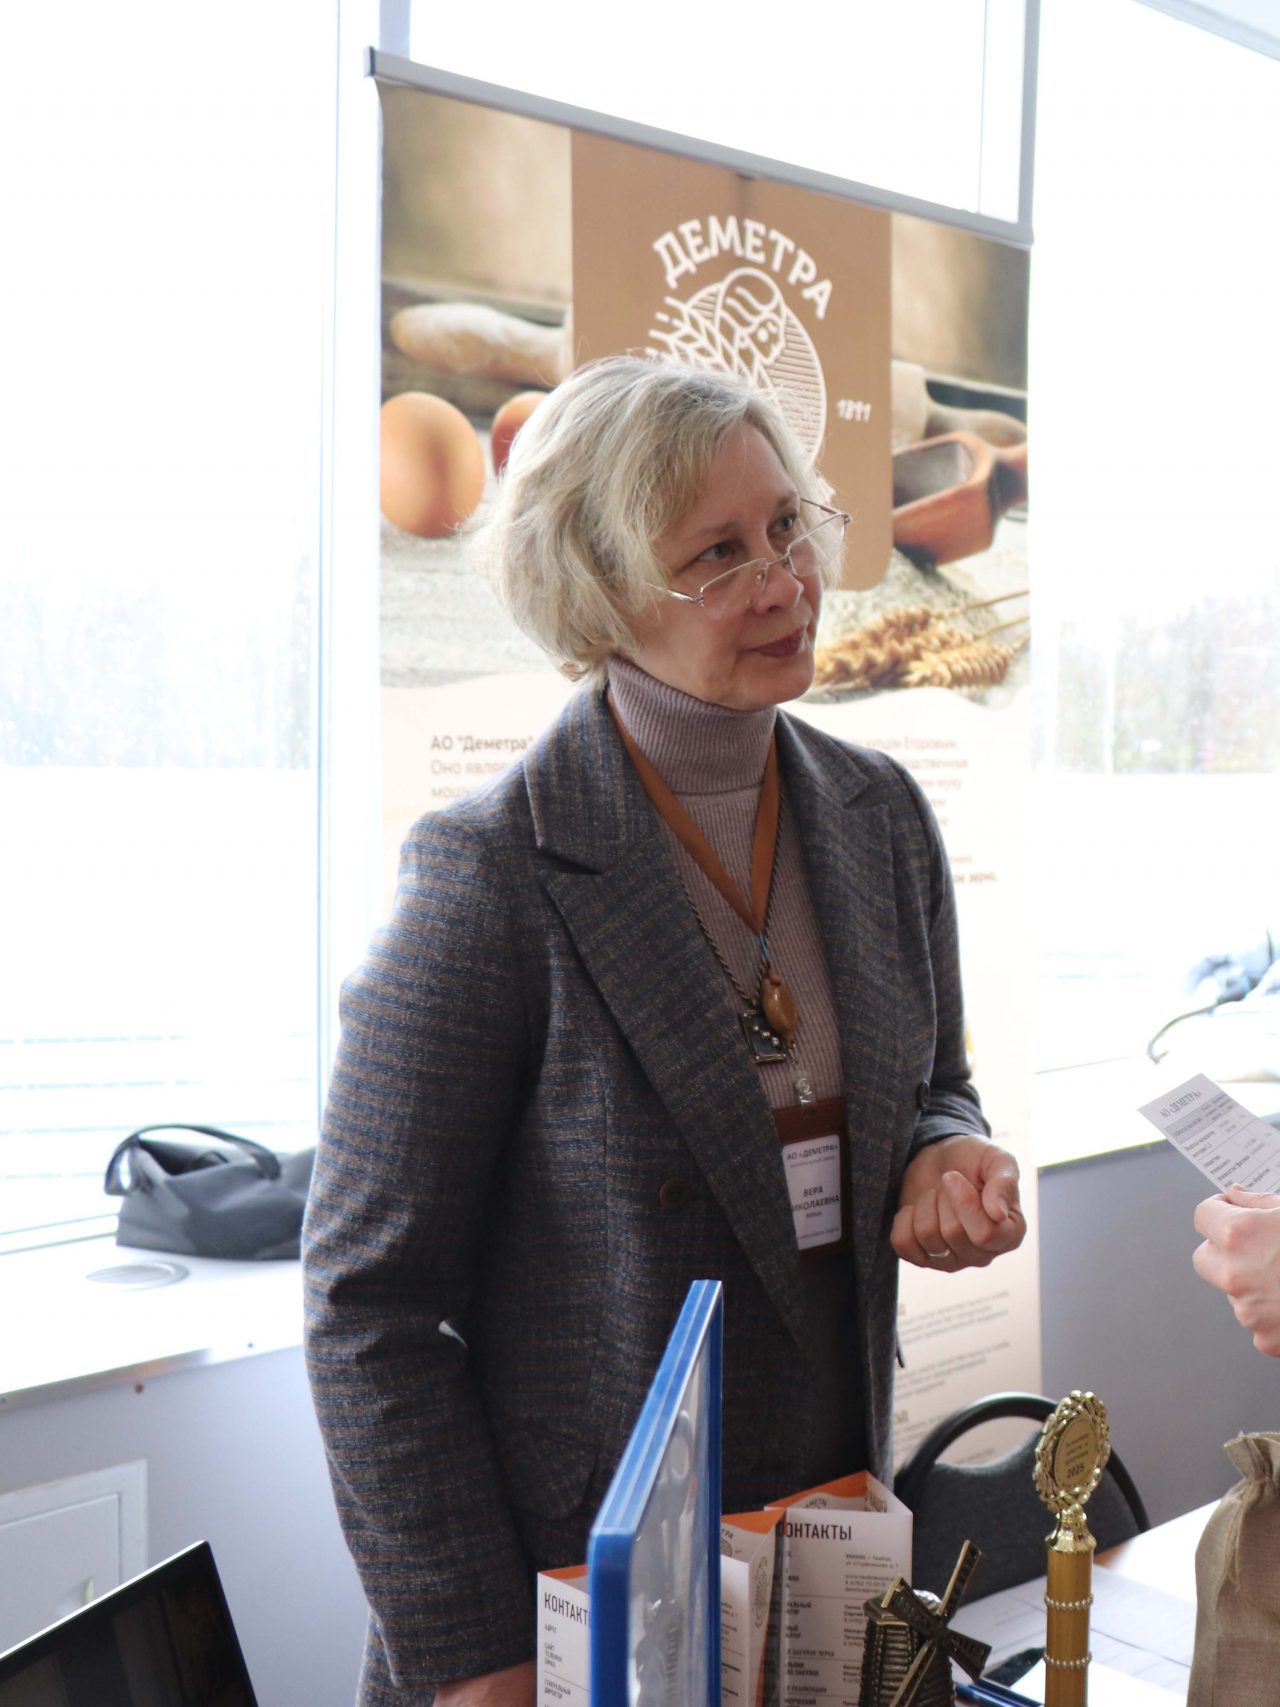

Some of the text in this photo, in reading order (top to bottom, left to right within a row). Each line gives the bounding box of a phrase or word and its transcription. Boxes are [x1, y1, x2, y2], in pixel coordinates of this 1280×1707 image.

[652, 215, 833, 320] ДЕМЕТРА
[431, 735, 454, 750] АО
[431, 760, 462, 775] Оно
[786, 1152, 797, 1160] АО
[803, 1186, 824, 1197] ВЕРА
[545, 1623, 557, 1634] АДРЕС
